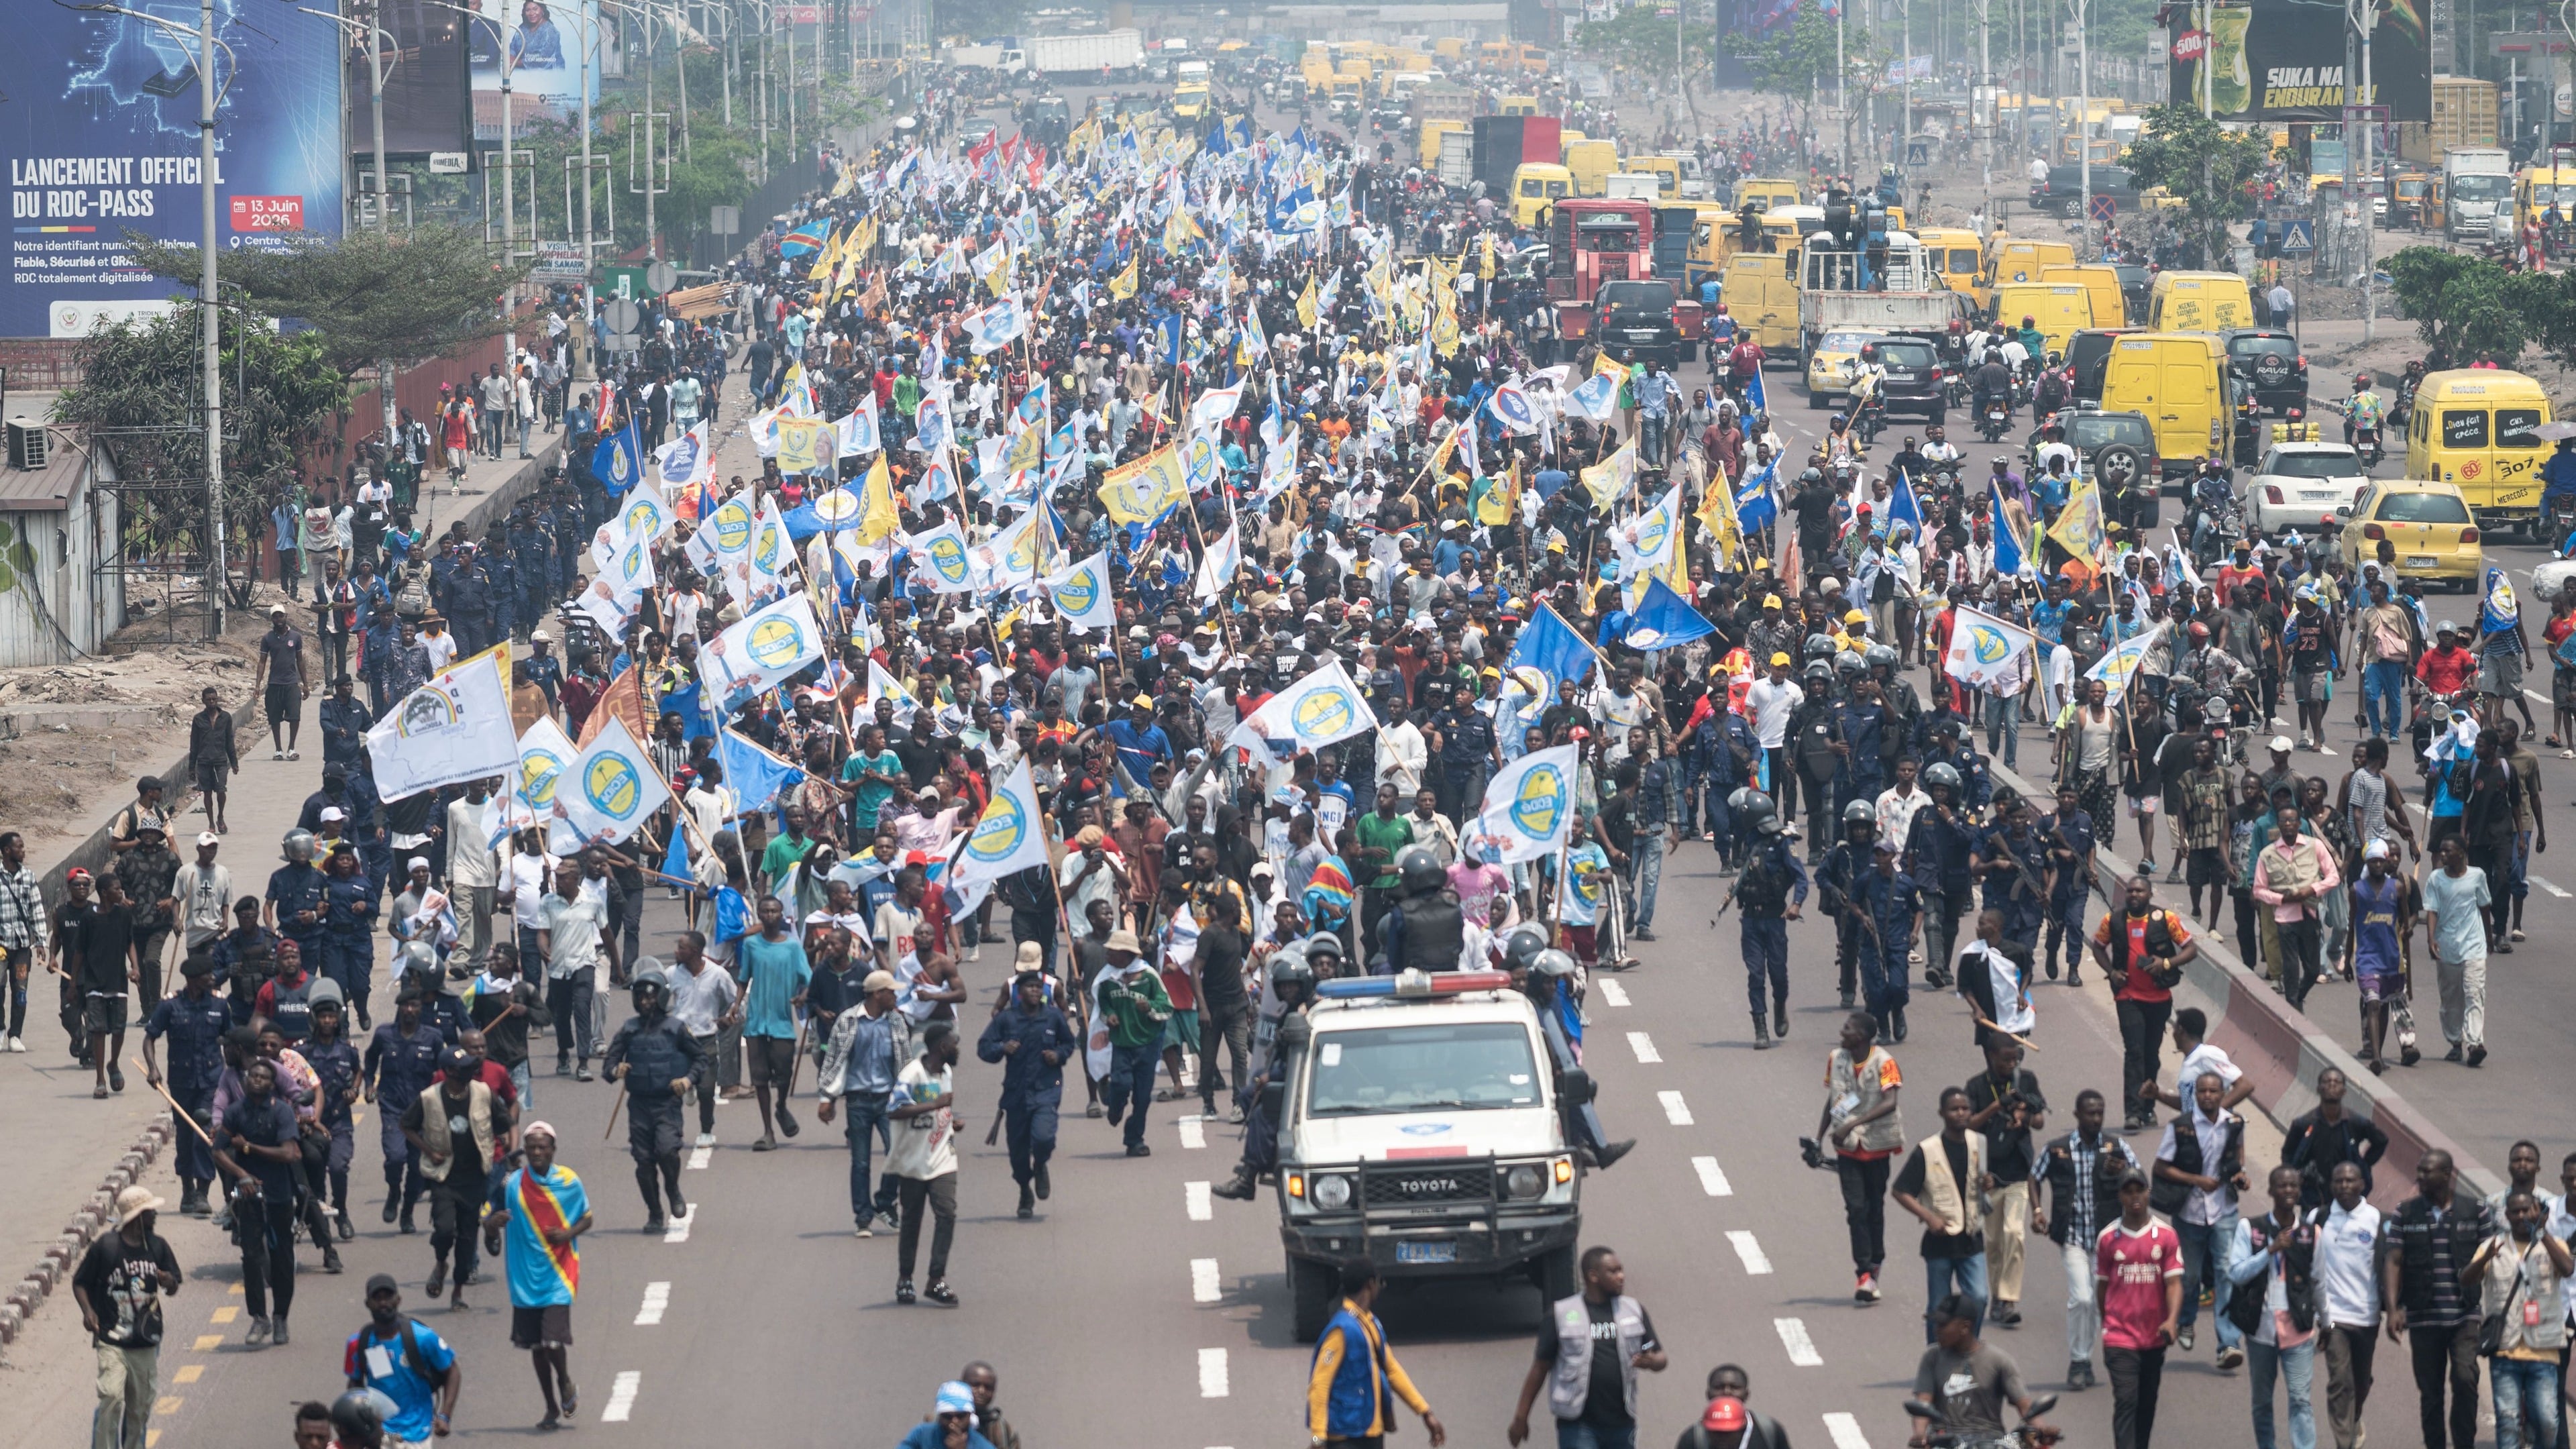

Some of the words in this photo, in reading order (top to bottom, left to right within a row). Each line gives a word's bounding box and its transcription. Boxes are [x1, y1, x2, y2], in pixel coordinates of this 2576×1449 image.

[2267, 67, 2314, 88] SUKA
[2318, 66, 2343, 86] NA
[2263, 85, 2378, 108] ENDURANE!
[12, 158, 134, 186] LANCEMENT
[141, 157, 225, 184] OFFICIL
[13, 191, 40, 218] DU
[47, 189, 154, 217] RDC-PASS
[251, 201, 264, 212] 13
[268, 200, 299, 212] Juin
[252, 215, 290, 227] 2026
[15, 241, 44, 252] Notre
[45, 239, 100, 252] identifiant
[245, 236, 281, 246] Centre
[14, 256, 48, 269] Fiable,
[50, 255, 96, 268] Sécurisé
[97, 257, 109, 267] et
[14, 273, 36, 283] RDC
[38, 272, 97, 282] totalement
[99, 272, 154, 285] digitalisée
[1948, 335, 1960, 348] 13
[2257, 366, 2288, 375] RAV4
[2466, 415, 2480, 427] fait
[2497, 488, 2528, 505] MERCEDES
[2299, 636, 2318, 651] 23
[278, 1003, 309, 1013] PRESS
[1400, 1179, 1458, 1192] TOYOTA
